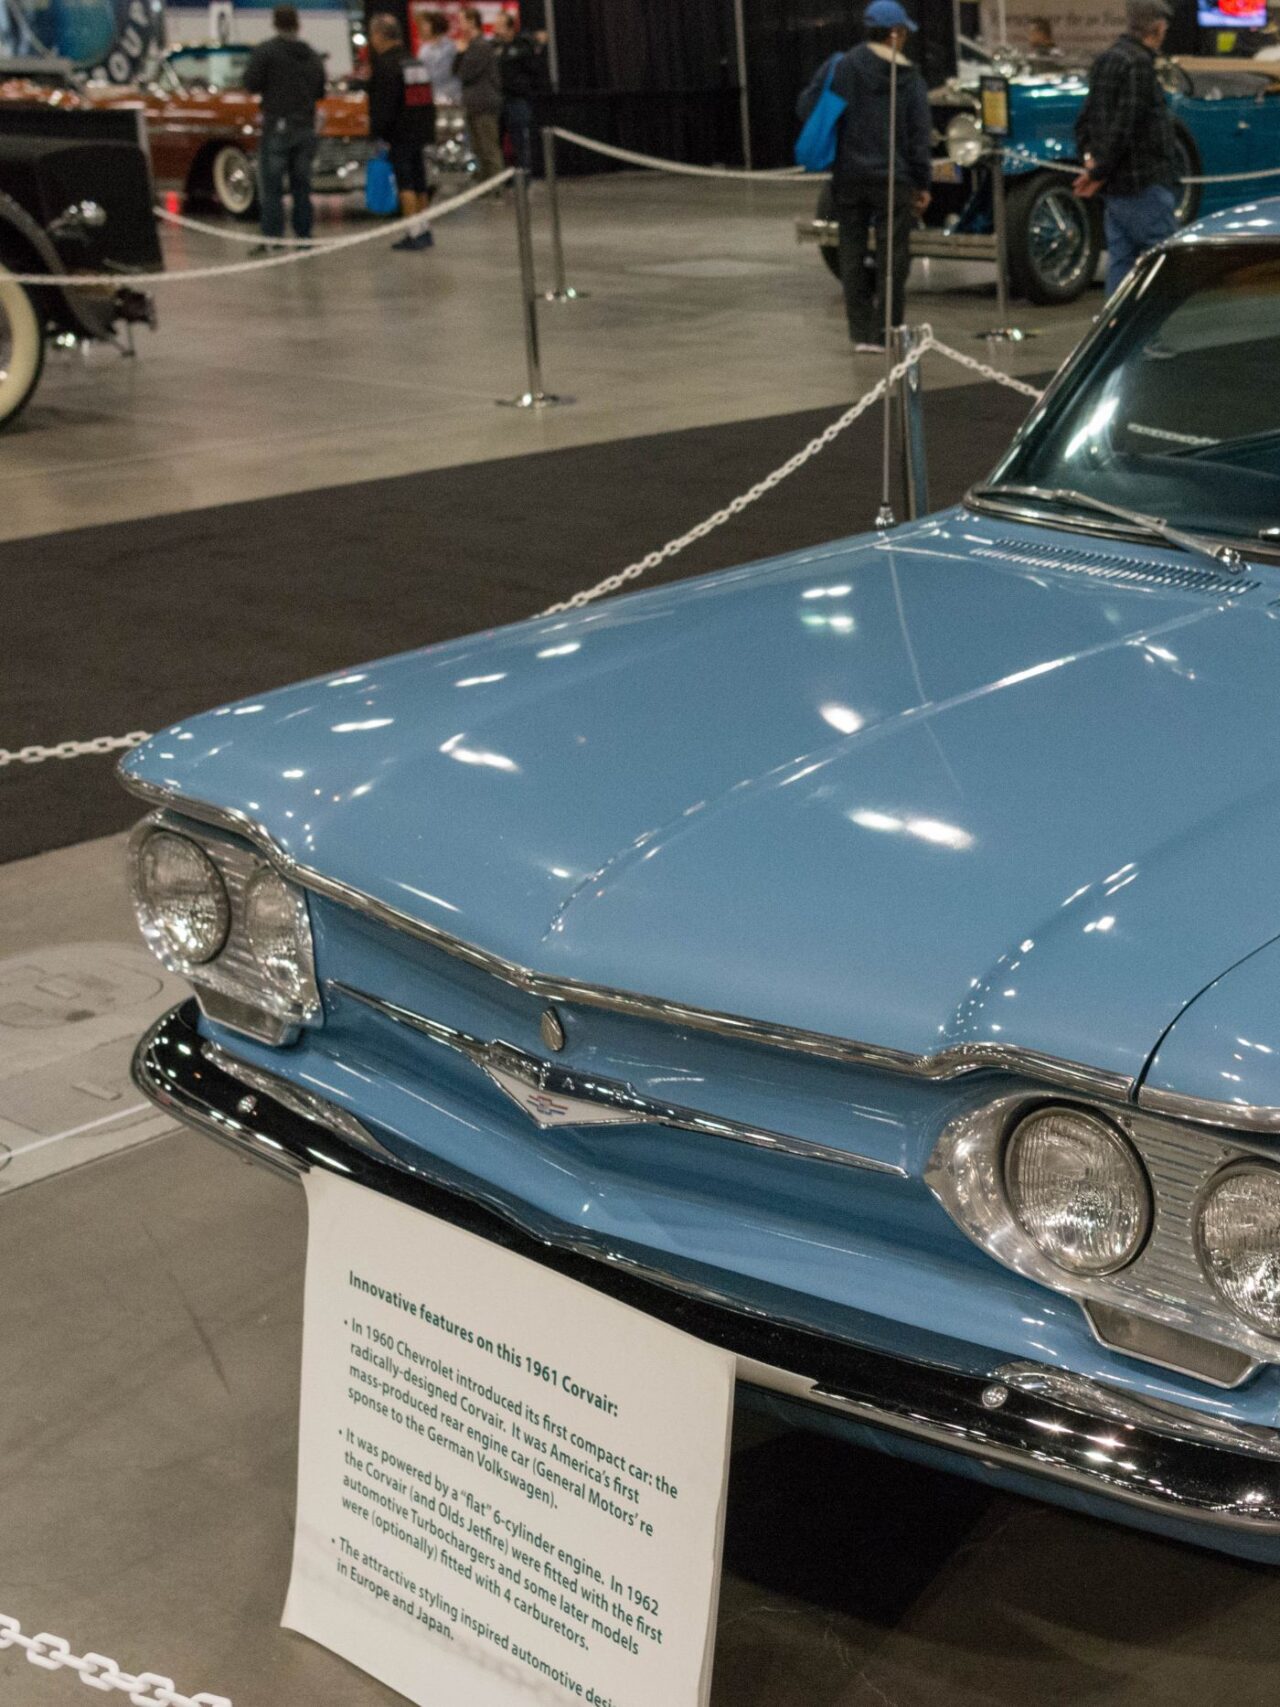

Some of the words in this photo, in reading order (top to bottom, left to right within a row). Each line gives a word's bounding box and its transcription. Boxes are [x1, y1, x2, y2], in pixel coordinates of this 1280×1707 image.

[349, 1270, 417, 1316] Innovative
[419, 1303, 474, 1344] features
[476, 1336, 493, 1354] on
[496, 1343, 522, 1368] this
[526, 1357, 557, 1386] 1961
[562, 1375, 618, 1417] Corvair:
[351, 1343, 457, 1406] radically-designed
[460, 1396, 506, 1432] Corvair.
[512, 1422, 521, 1440] It
[523, 1432, 547, 1454] was
[613, 1476, 639, 1504] first
[352, 1318, 362, 1335] In
[366, 1325, 394, 1350] 1960
[396, 1340, 453, 1381] Chevrolet
[456, 1369, 522, 1417] introduced
[525, 1405, 540, 1426] its
[543, 1414, 568, 1440] first
[570, 1433, 626, 1472] compact
[628, 1464, 653, 1486] car:
[655, 1475, 678, 1499] the
[346, 1428, 355, 1444] It
[357, 1437, 379, 1457] was
[381, 1450, 432, 1486] powered
[434, 1474, 449, 1498] by
[451, 1489, 458, 1501] a
[493, 1510, 555, 1555] 6-cylinder
[557, 1549, 604, 1585] engine.
[610, 1575, 623, 1595] In
[627, 1586, 659, 1616] 1962
[348, 1387, 388, 1417] sponse
[391, 1408, 403, 1424] to
[405, 1415, 425, 1436] the
[427, 1426, 474, 1462] German
[477, 1451, 558, 1509] Volkswagen).
[349, 1365, 438, 1419] mass-produced
[440, 1412, 464, 1432] rear
[467, 1427, 508, 1457] engine
[511, 1450, 530, 1468] car
[533, 1458, 586, 1499] (General
[640, 1520, 653, 1537] re
[337, 1558, 347, 1576] in
[350, 1566, 390, 1601] Europe
[392, 1595, 414, 1616] and
[416, 1607, 454, 1641] Japan.
[340, 1536, 360, 1560] The
[362, 1554, 416, 1593] attractive
[419, 1587, 458, 1622] styling
[461, 1608, 509, 1650] inspired
[511, 1644, 583, 1696] automotive
[342, 1497, 369, 1520] were
[372, 1511, 438, 1561] (optionally)
[440, 1549, 472, 1580] fitted
[475, 1573, 501, 1597] with
[503, 1588, 511, 1603] 4
[514, 1597, 589, 1651] carburetors.
[343, 1475, 408, 1519] automotive
[411, 1509, 495, 1570] Turbochargers
[498, 1563, 521, 1585] and
[524, 1578, 557, 1606] some
[560, 1594, 589, 1624] later
[591, 1618, 639, 1655] models
[344, 1451, 363, 1471] the
[366, 1462, 407, 1494] Corvair
[410, 1486, 436, 1512] (and
[438, 1502, 464, 1528] Olds
[467, 1518, 508, 1555] Jetfire)
[512, 1546, 541, 1572] were
[544, 1561, 578, 1594] fitted
[581, 1586, 608, 1612] with
[612, 1603, 633, 1627] the
[636, 1615, 663, 1644] first
